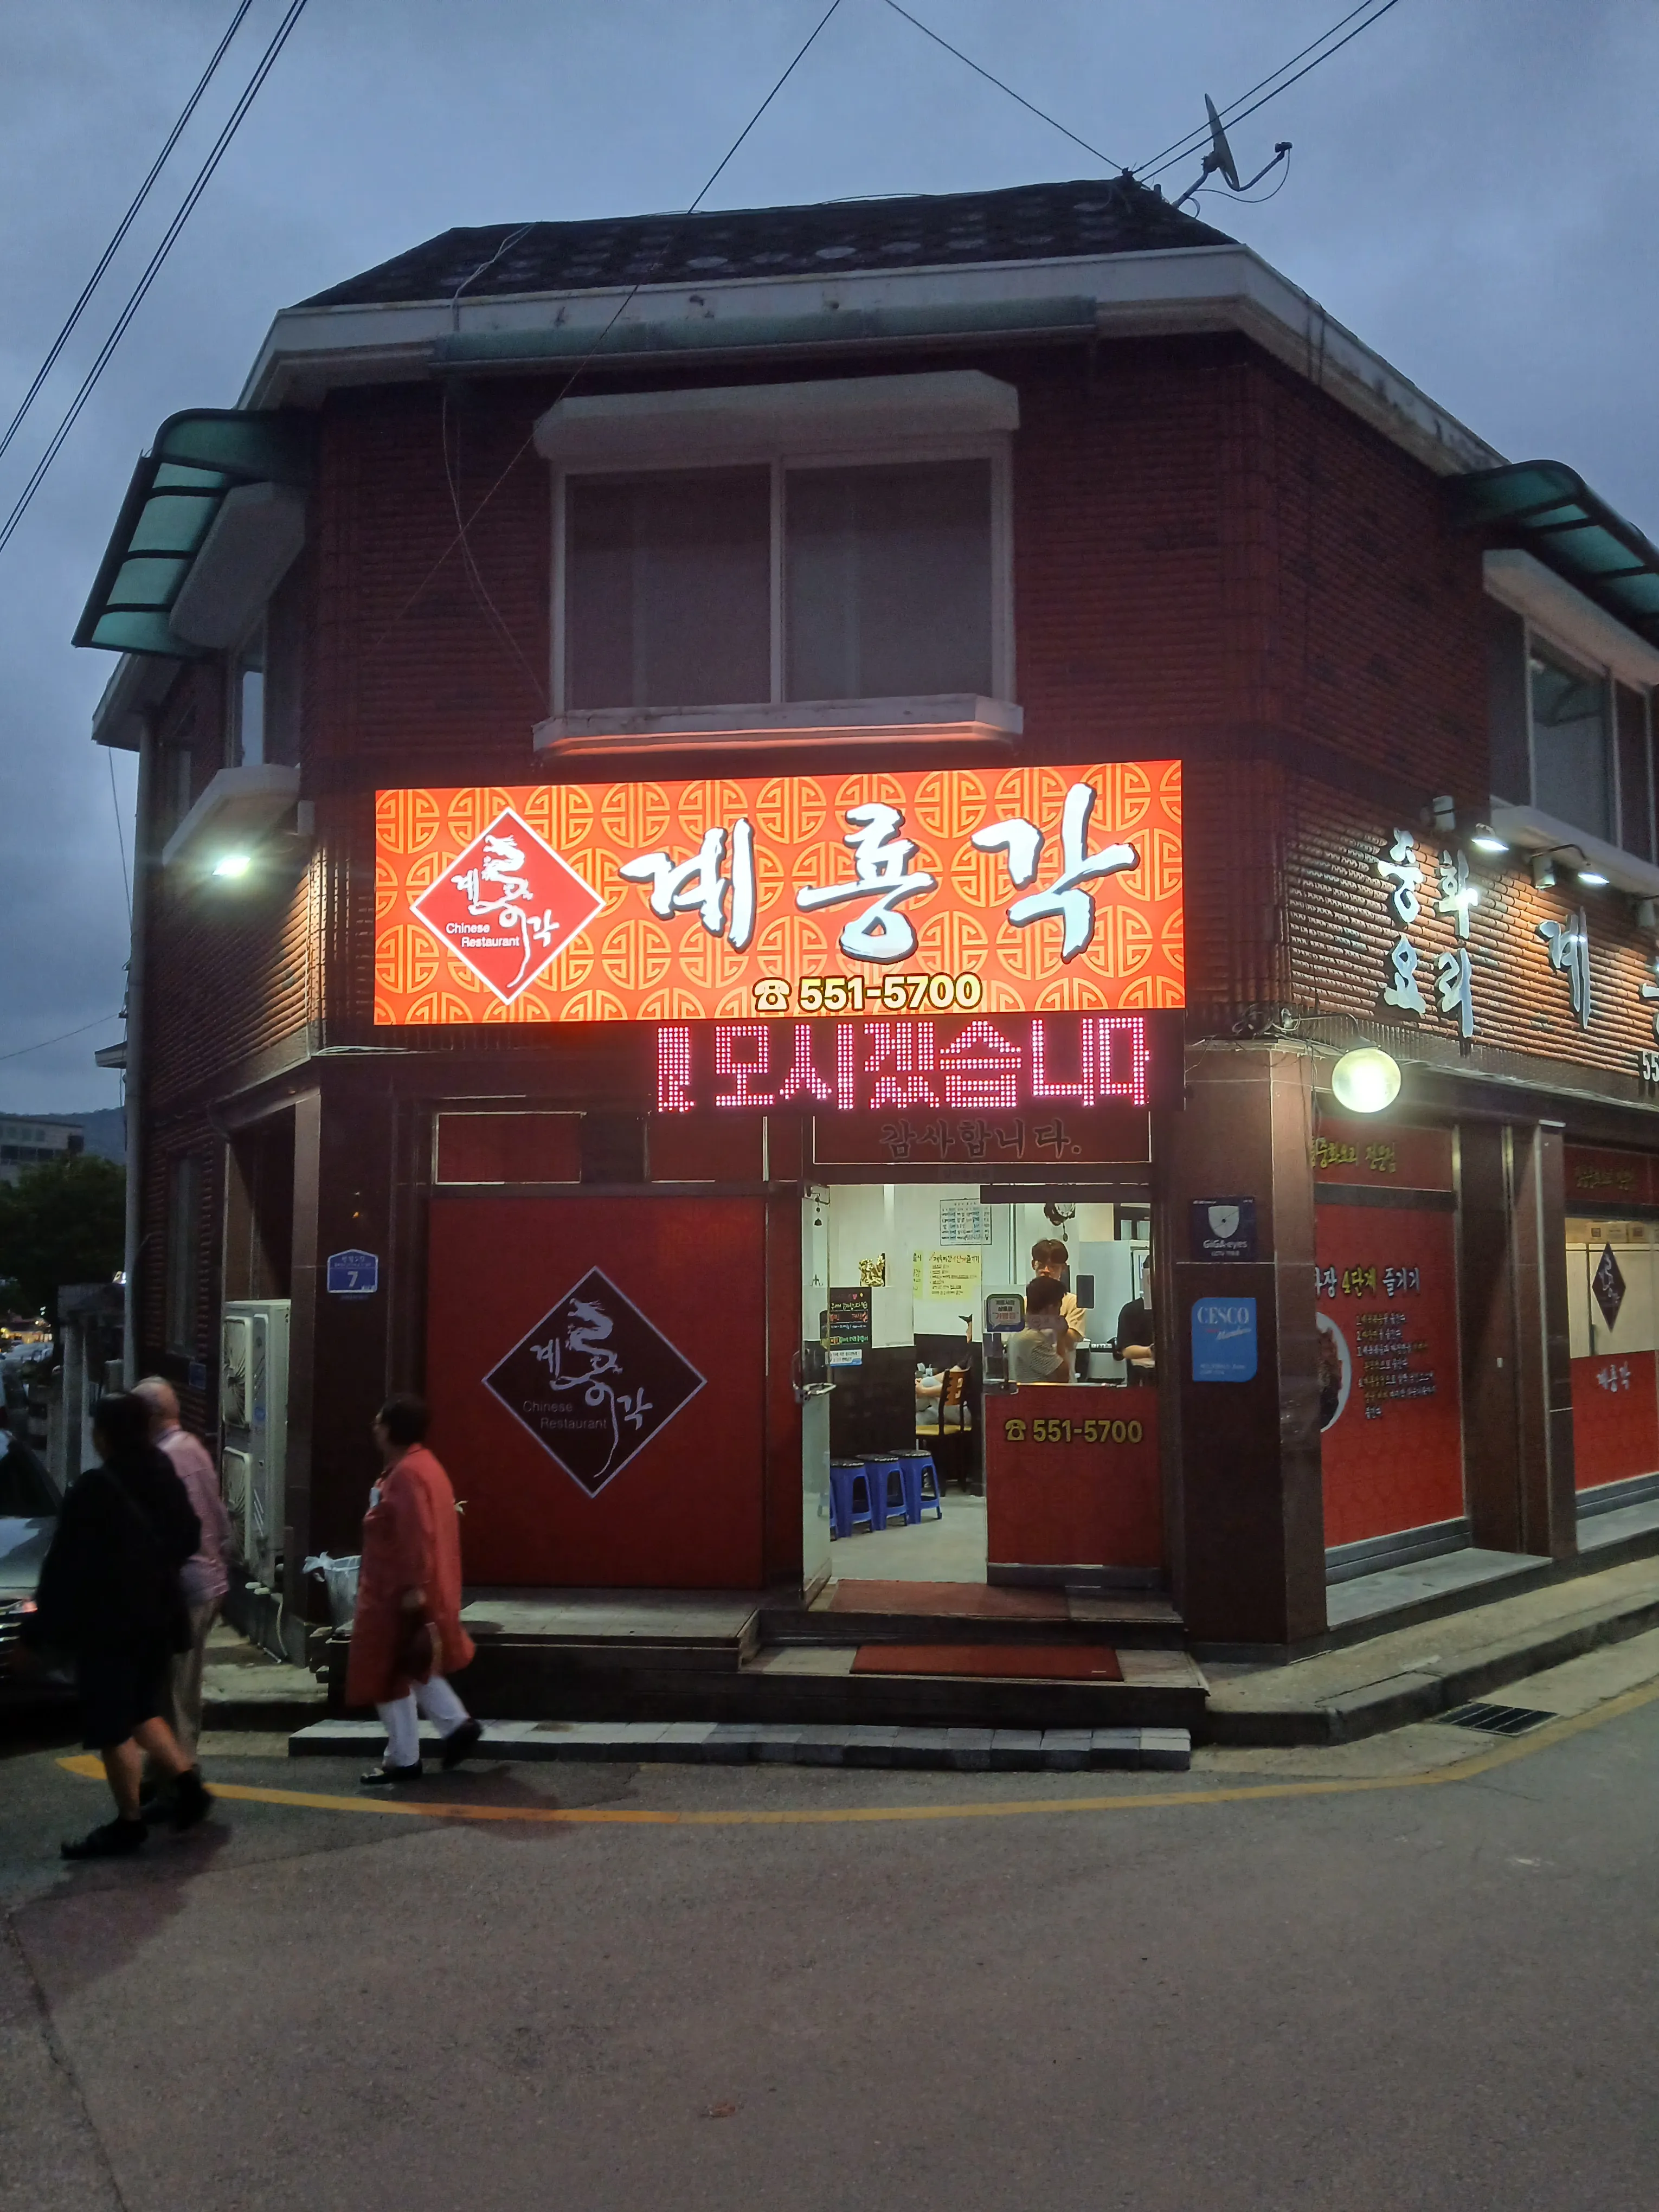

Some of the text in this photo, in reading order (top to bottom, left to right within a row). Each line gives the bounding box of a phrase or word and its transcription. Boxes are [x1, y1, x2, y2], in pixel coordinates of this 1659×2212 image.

[620, 782, 1140, 964] 계룡각
[446, 922, 490, 934] Chinese
[461, 936, 519, 948] Restaurant
[799, 973, 982, 1012] 551-5700
[715, 1017, 1150, 1111] 모시겠습니다
[879, 1118, 1082, 1159] 감사합니다.
[348, 1271, 358, 1287] 7
[1342, 1267, 1377, 1297] 4단계
[1382, 1266, 1420, 1297] 즐기기
[1197, 1307, 1249, 1324] CESCO
[541, 1417, 607, 1430] Restaurant
[1033, 1419, 1143, 1444] 551-5700
